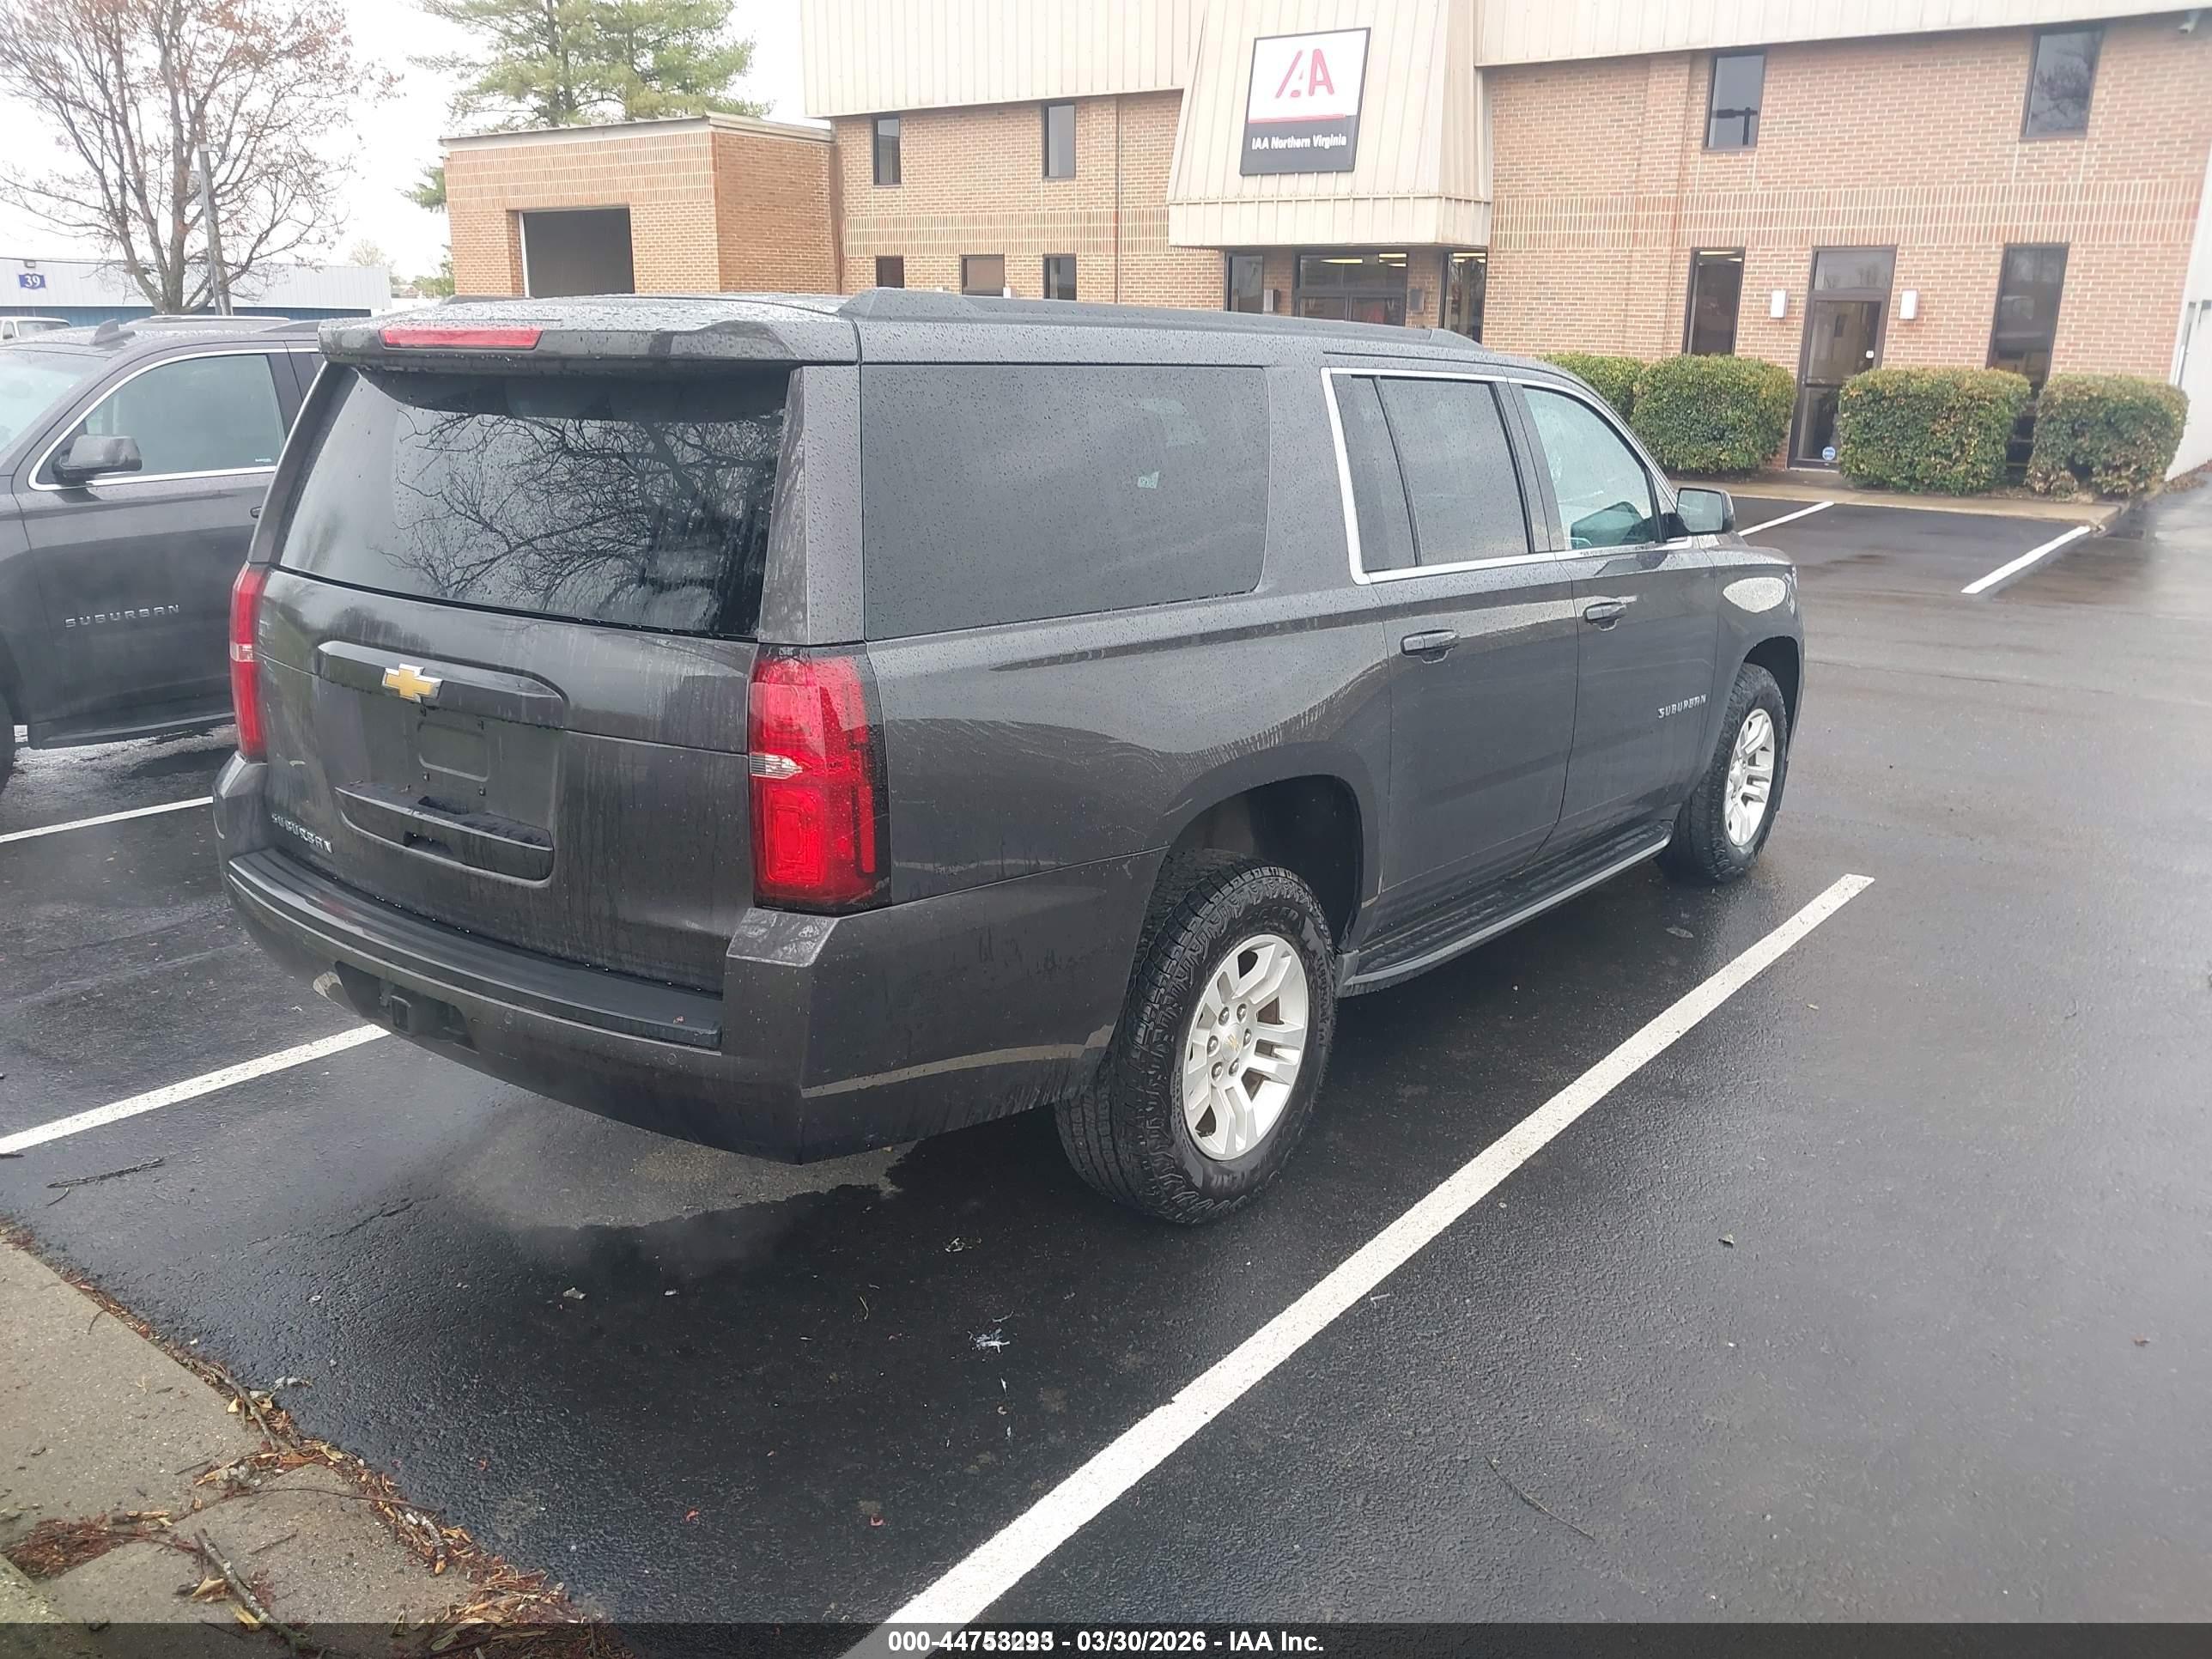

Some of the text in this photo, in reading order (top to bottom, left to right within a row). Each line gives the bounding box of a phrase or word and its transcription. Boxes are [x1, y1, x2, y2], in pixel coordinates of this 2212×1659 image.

[1252, 133, 1347, 150] IAA Northern Virginia
[24, 276, 41, 288] 39
[64, 604, 179, 629] SUBURBAN
[1657, 694, 1706, 719] SUBURBAN
[270, 812, 334, 854] SUBURBAN
